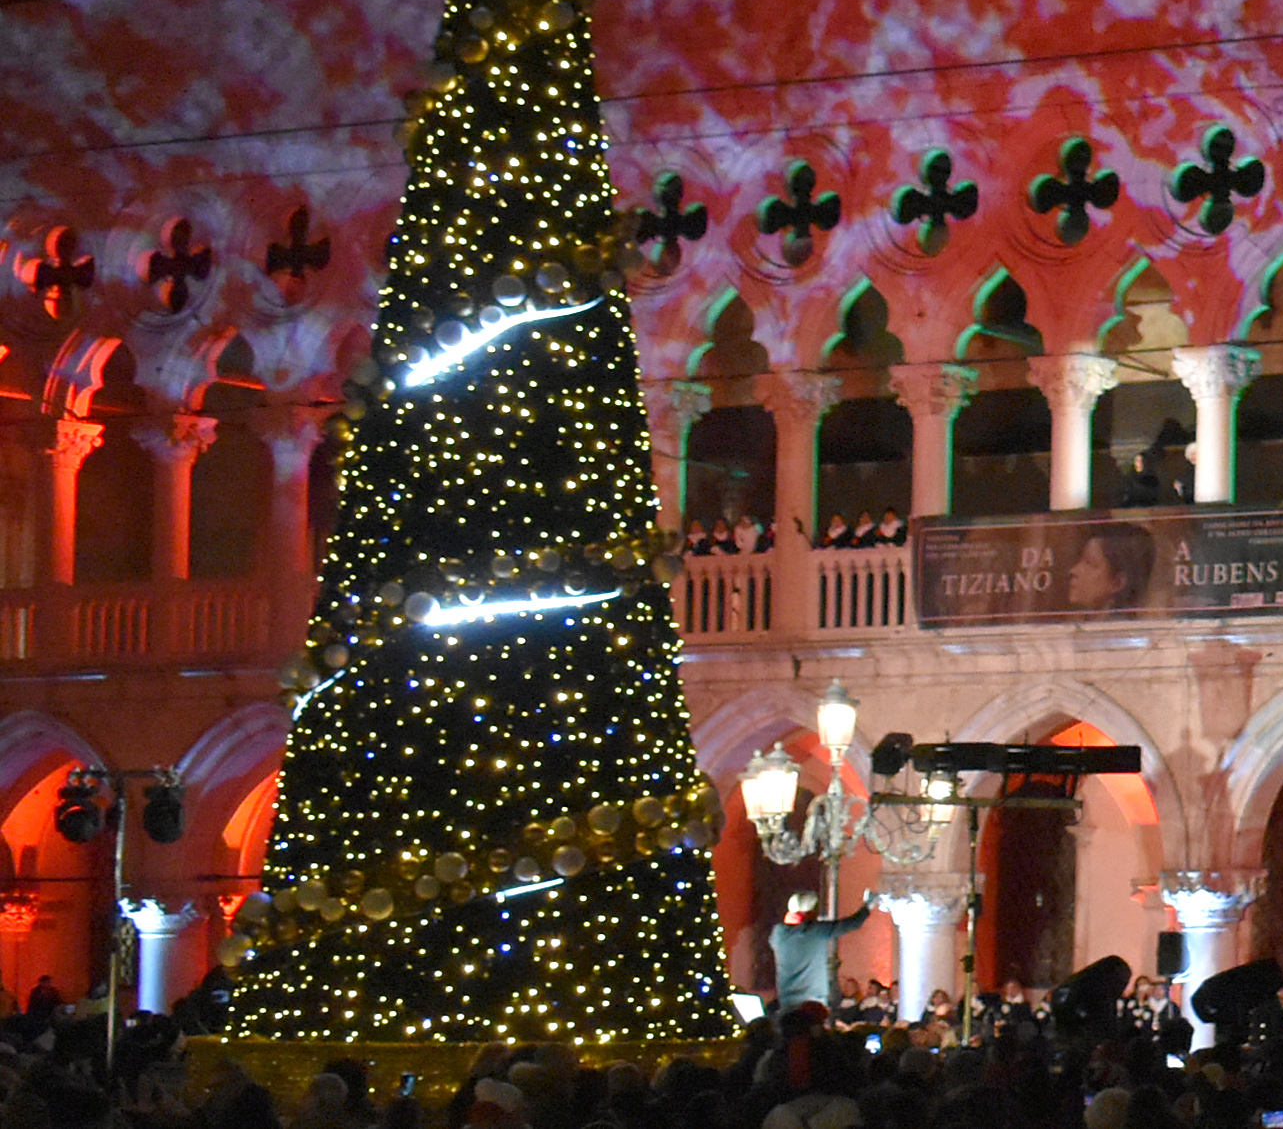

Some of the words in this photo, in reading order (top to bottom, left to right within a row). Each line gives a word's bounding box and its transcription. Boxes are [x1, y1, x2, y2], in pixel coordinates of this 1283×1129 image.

[1022, 547, 1054, 568] DA
[1173, 540, 1191, 561] A
[942, 572, 1053, 596] TIZIANO
[1174, 560, 1279, 586] RUBENS
